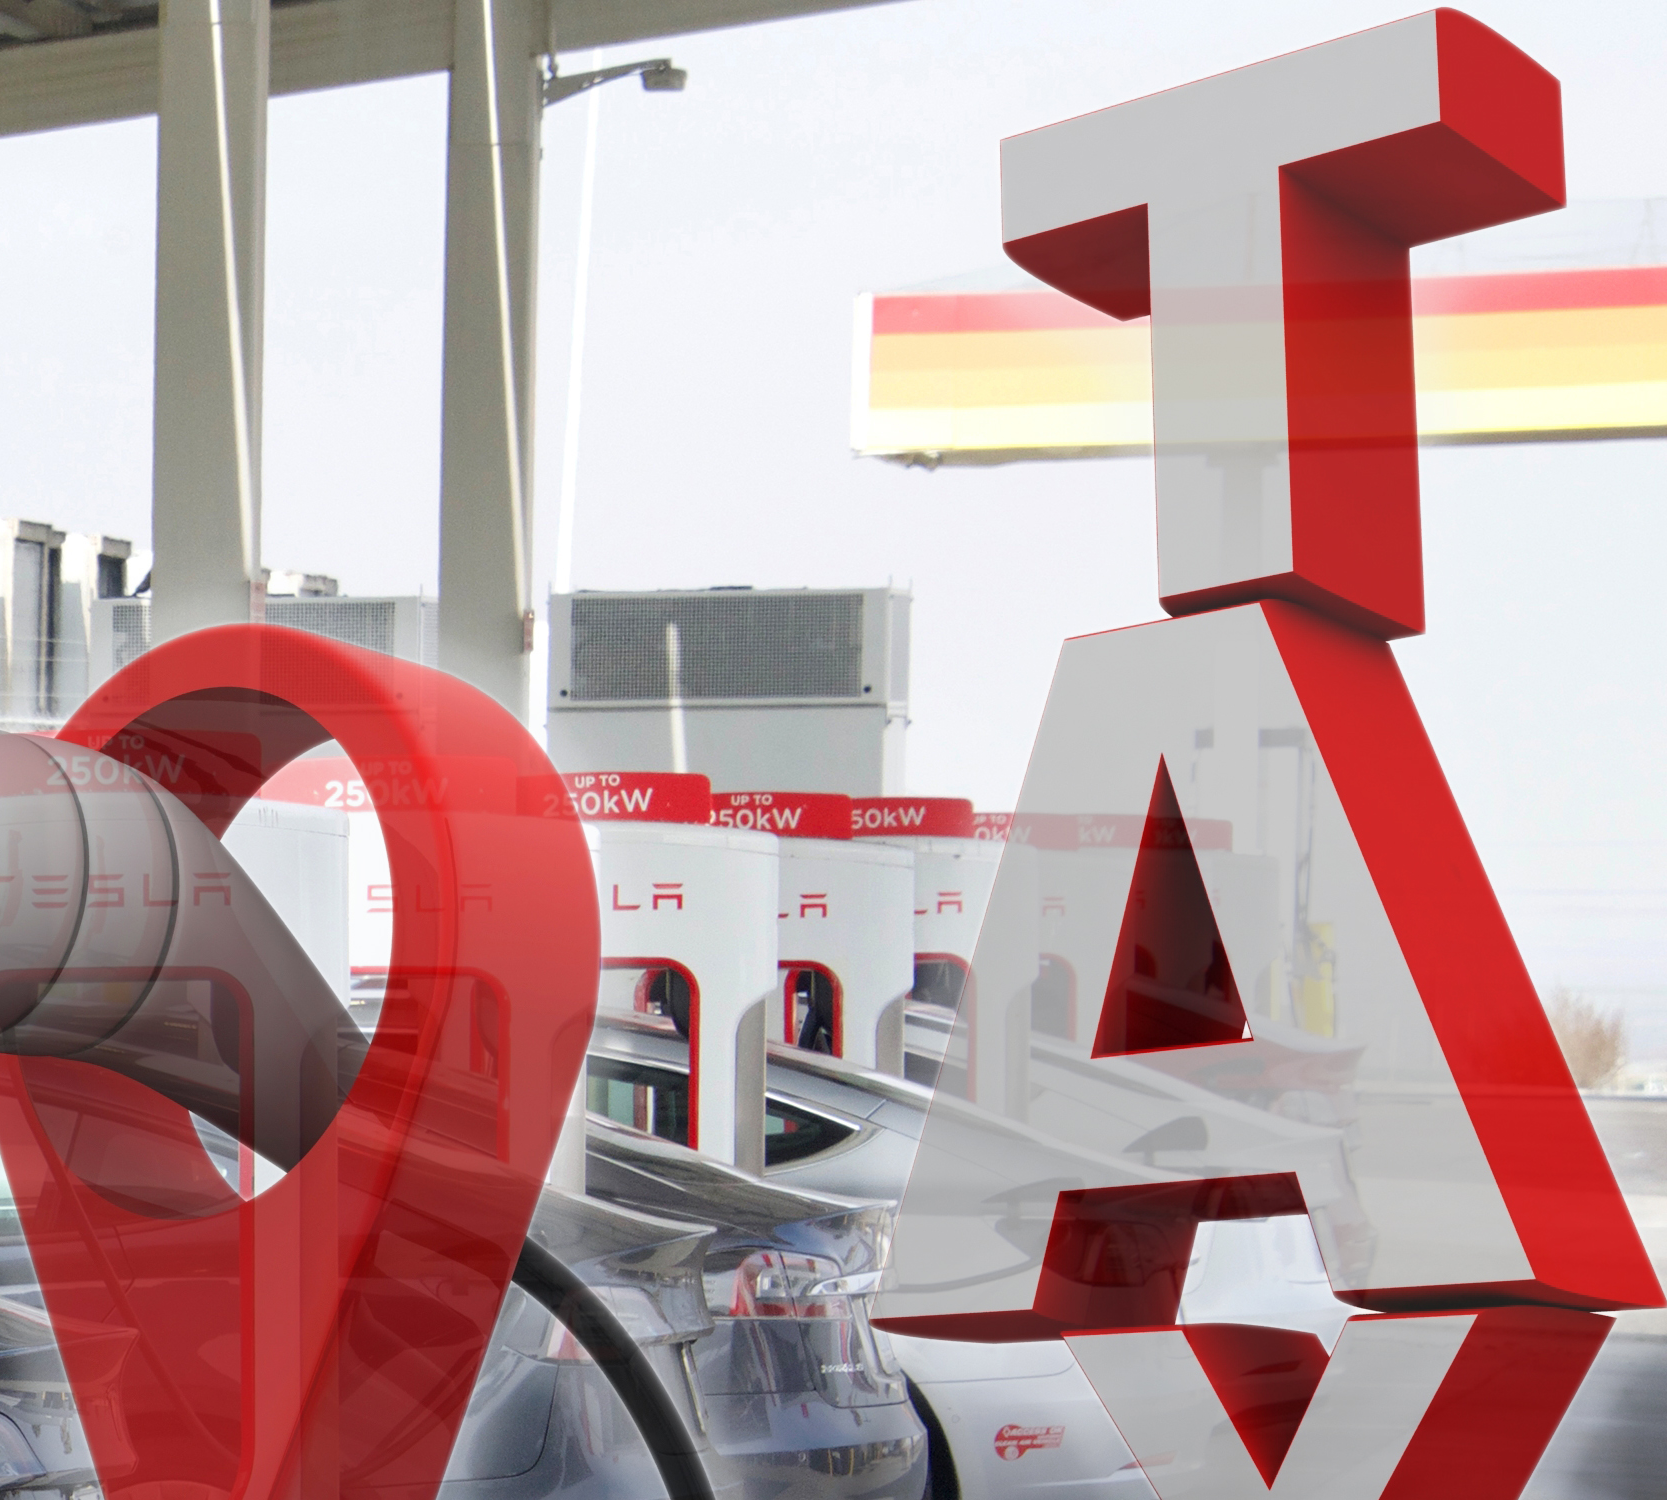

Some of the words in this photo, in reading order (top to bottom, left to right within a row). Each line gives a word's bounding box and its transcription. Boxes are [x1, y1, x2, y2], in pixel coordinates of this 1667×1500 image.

[87, 735, 113, 751] UP
[118, 734, 145, 750] TO
[46, 754, 186, 786] 250kW
[574, 775, 596, 789] UP
[598, 774, 621, 787] TO
[324, 777, 449, 808] 250kW
[730, 794, 750, 806] UP
[752, 794, 773, 806] TO
[851, 806, 926, 830] 50kW
[366, 883, 493, 913] SLA
